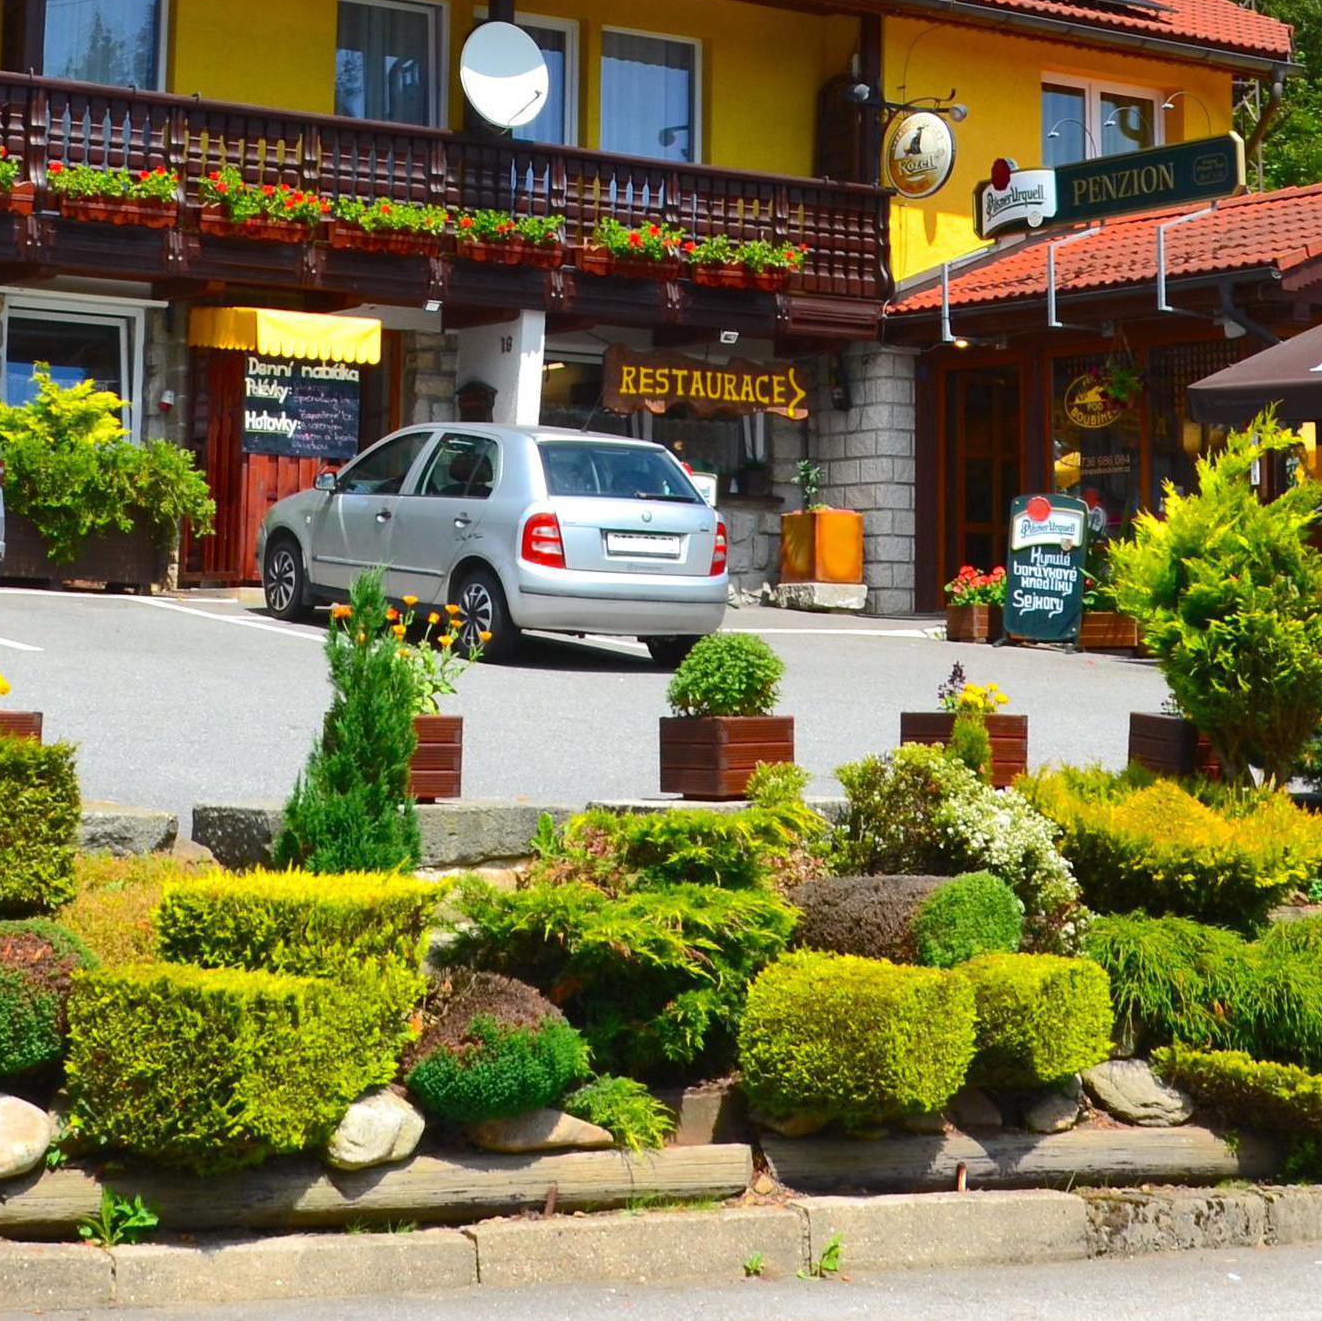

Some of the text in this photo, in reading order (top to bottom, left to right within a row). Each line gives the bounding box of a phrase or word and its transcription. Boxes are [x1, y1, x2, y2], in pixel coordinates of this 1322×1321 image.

[1072, 162, 1175, 206] PENZION
[986, 185, 1045, 221] Pilsner Urquell
[248, 357, 294, 377] Denní
[619, 365, 786, 403] RESTAURACE
[245, 409, 301, 438] Hotovky:
